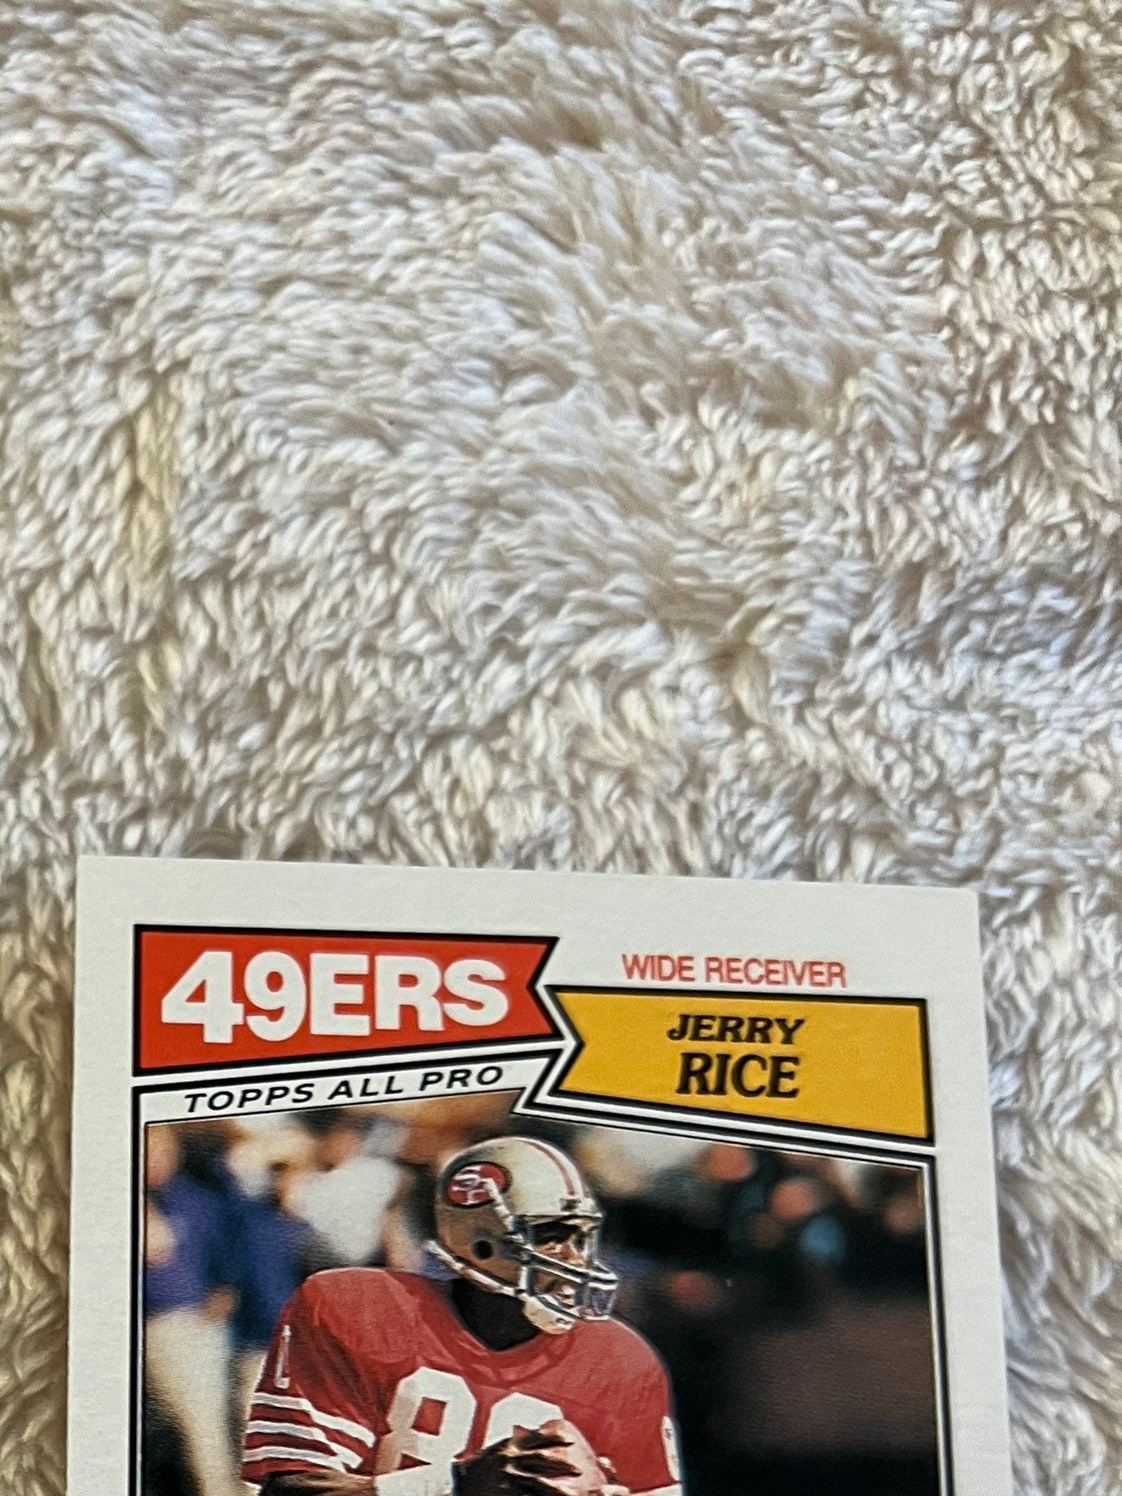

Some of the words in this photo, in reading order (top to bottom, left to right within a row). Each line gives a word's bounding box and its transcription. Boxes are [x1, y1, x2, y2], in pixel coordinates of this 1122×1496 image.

[622, 953, 696, 982] WIDE
[704, 956, 848, 988] RECEIVER
[161, 950, 509, 1044] 49ERS
[666, 1013, 805, 1046] JERRY
[184, 1082, 316, 1113] TOPPS
[327, 1075, 404, 1101] ALL
[419, 1065, 504, 1091] PRO
[675, 1051, 802, 1098] RICE
